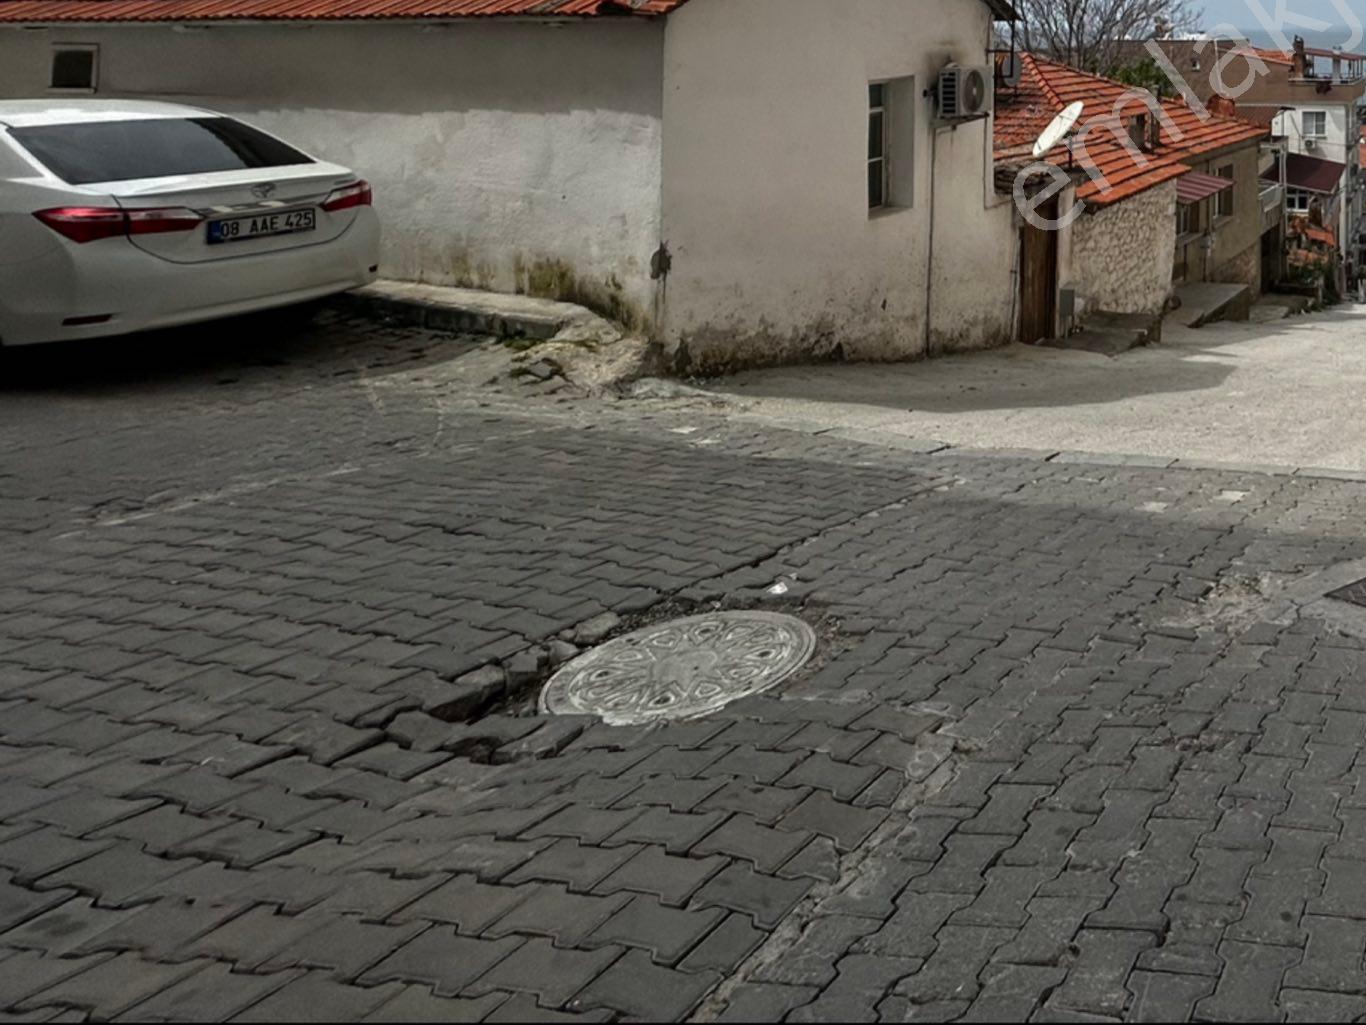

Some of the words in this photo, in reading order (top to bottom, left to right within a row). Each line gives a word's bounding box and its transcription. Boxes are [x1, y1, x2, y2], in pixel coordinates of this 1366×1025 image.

[220, 222, 240, 238] 08
[249, 216, 279, 234] AAE
[284, 212, 312, 229] 425
